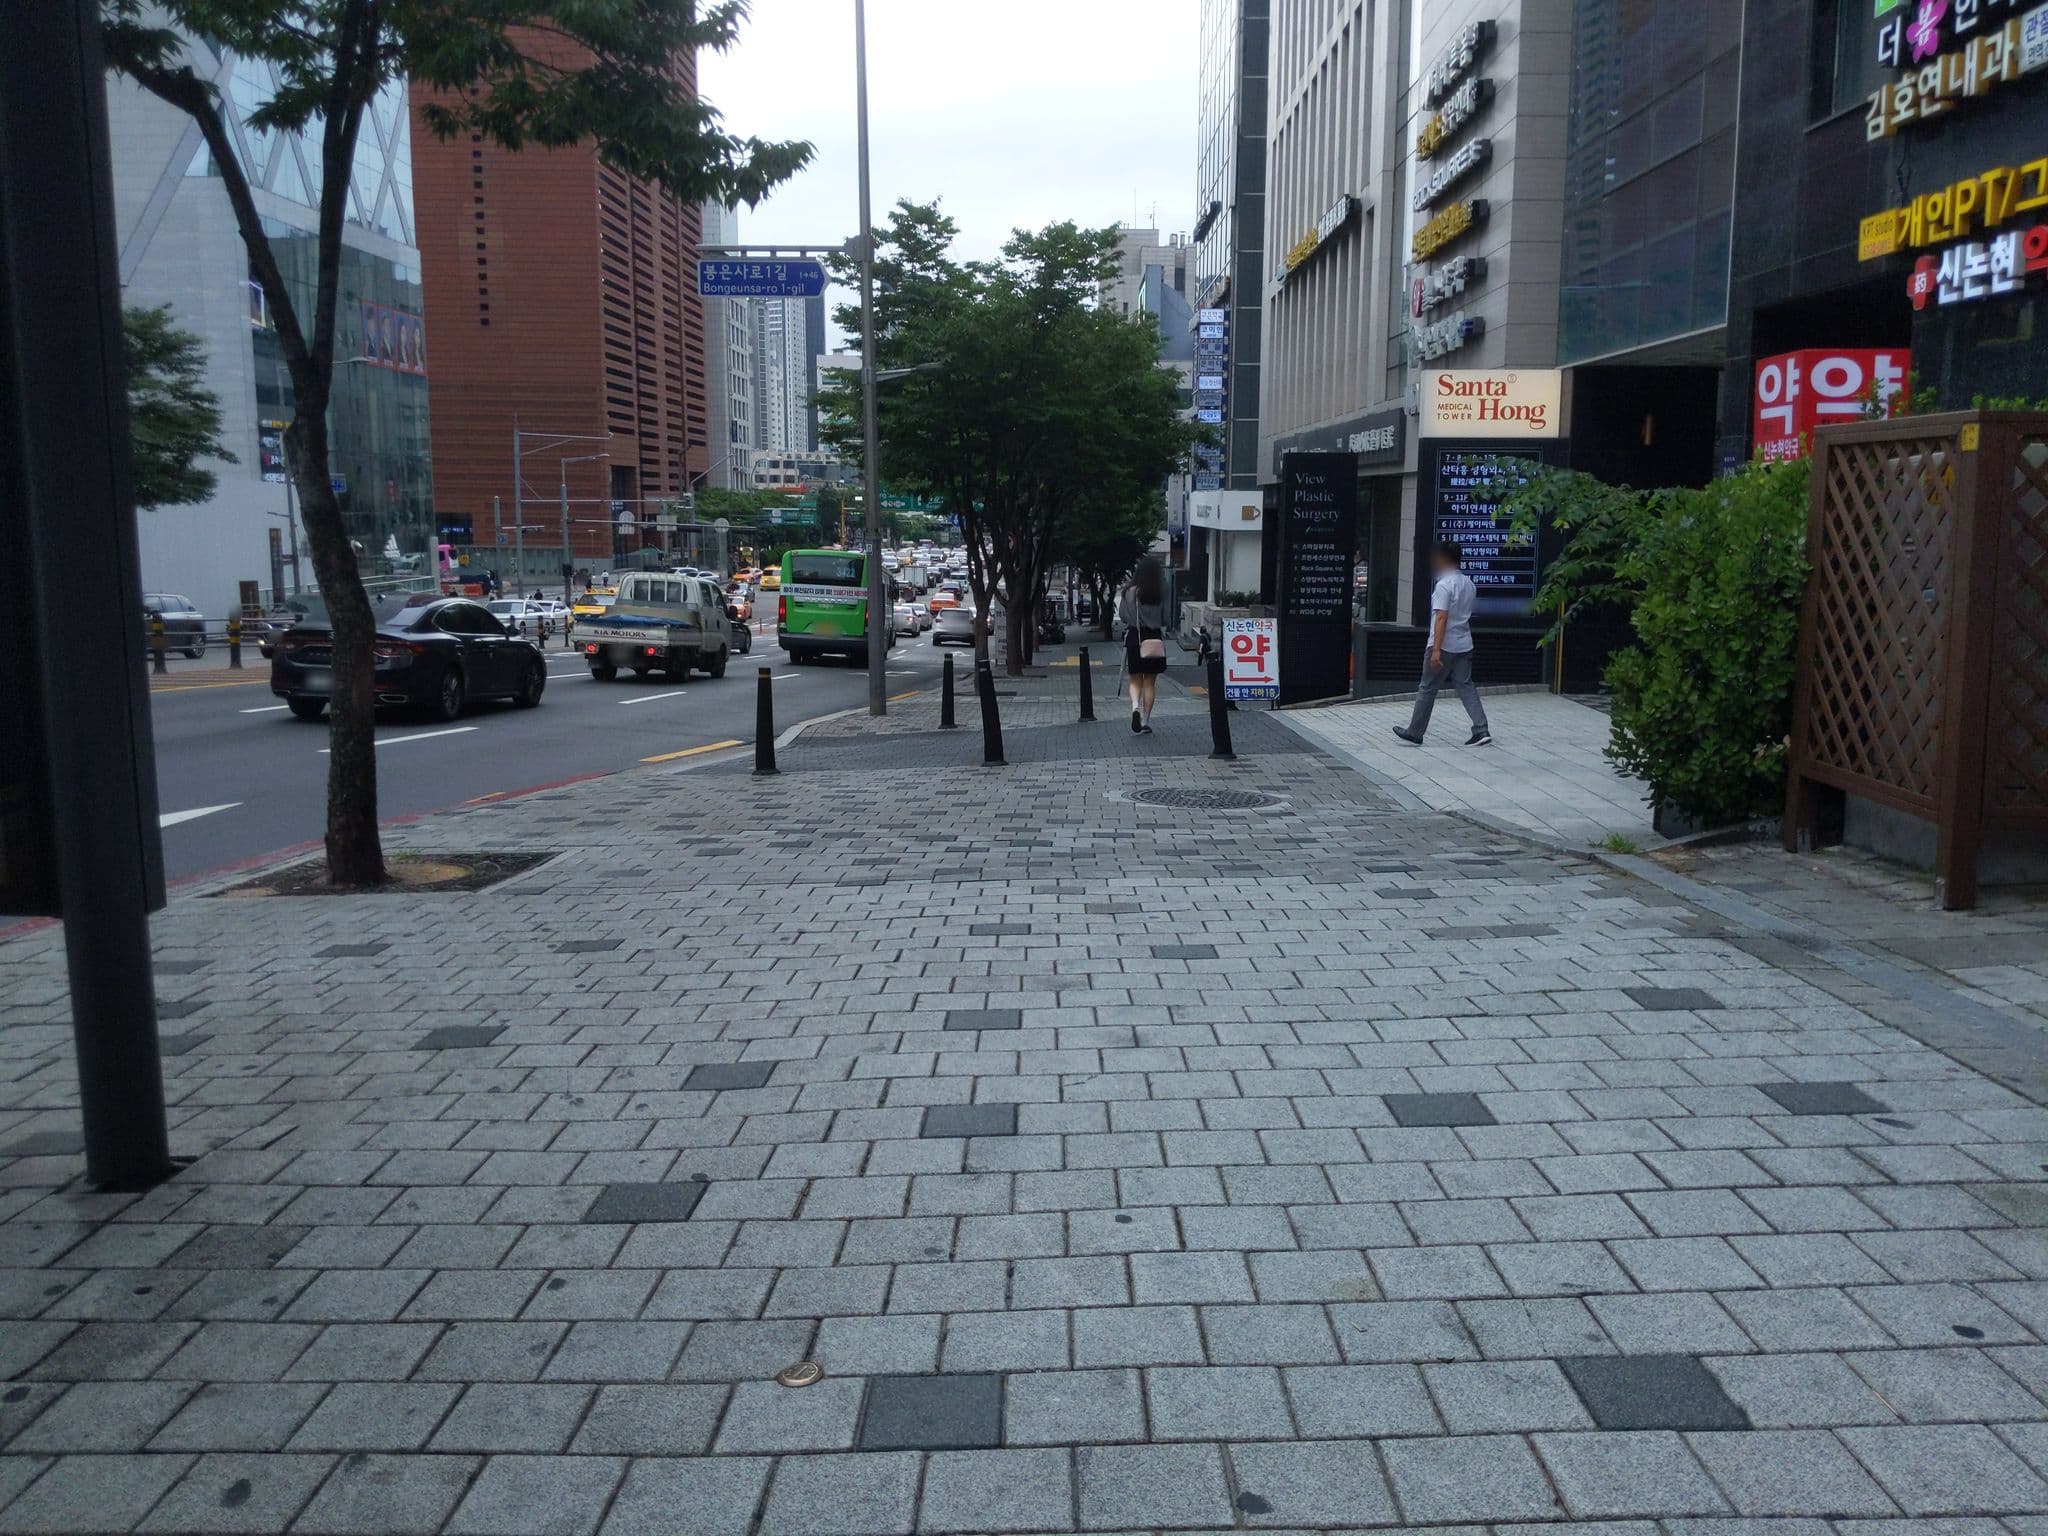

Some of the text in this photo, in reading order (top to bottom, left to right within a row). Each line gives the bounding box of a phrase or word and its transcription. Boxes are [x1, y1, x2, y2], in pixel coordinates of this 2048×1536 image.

[1865, 19, 2015, 142] 김호연내과
[704, 264, 787, 281] 봉은사로1길
[704, 283, 805, 295] Bongeunsa-ro 1-gil
[1438, 374, 1507, 397] Santa
[1759, 357, 1800, 435] 약
[1437, 403, 1473, 411] MEDICAL
[1477, 398, 1547, 430] Hong
[1295, 472, 1326, 485] View
[1295, 490, 1335, 502] Plastic
[1293, 507, 1340, 522] Surgery
[1453, 520, 1466, 529] (주)
[1468, 561, 1489, 569] 한의원
[1226, 621, 1273, 632] 신논현약국
[1231, 634, 1270, 672] 약
[1227, 688, 1240, 698] 건물
[1250, 687, 1264, 697] 지하
